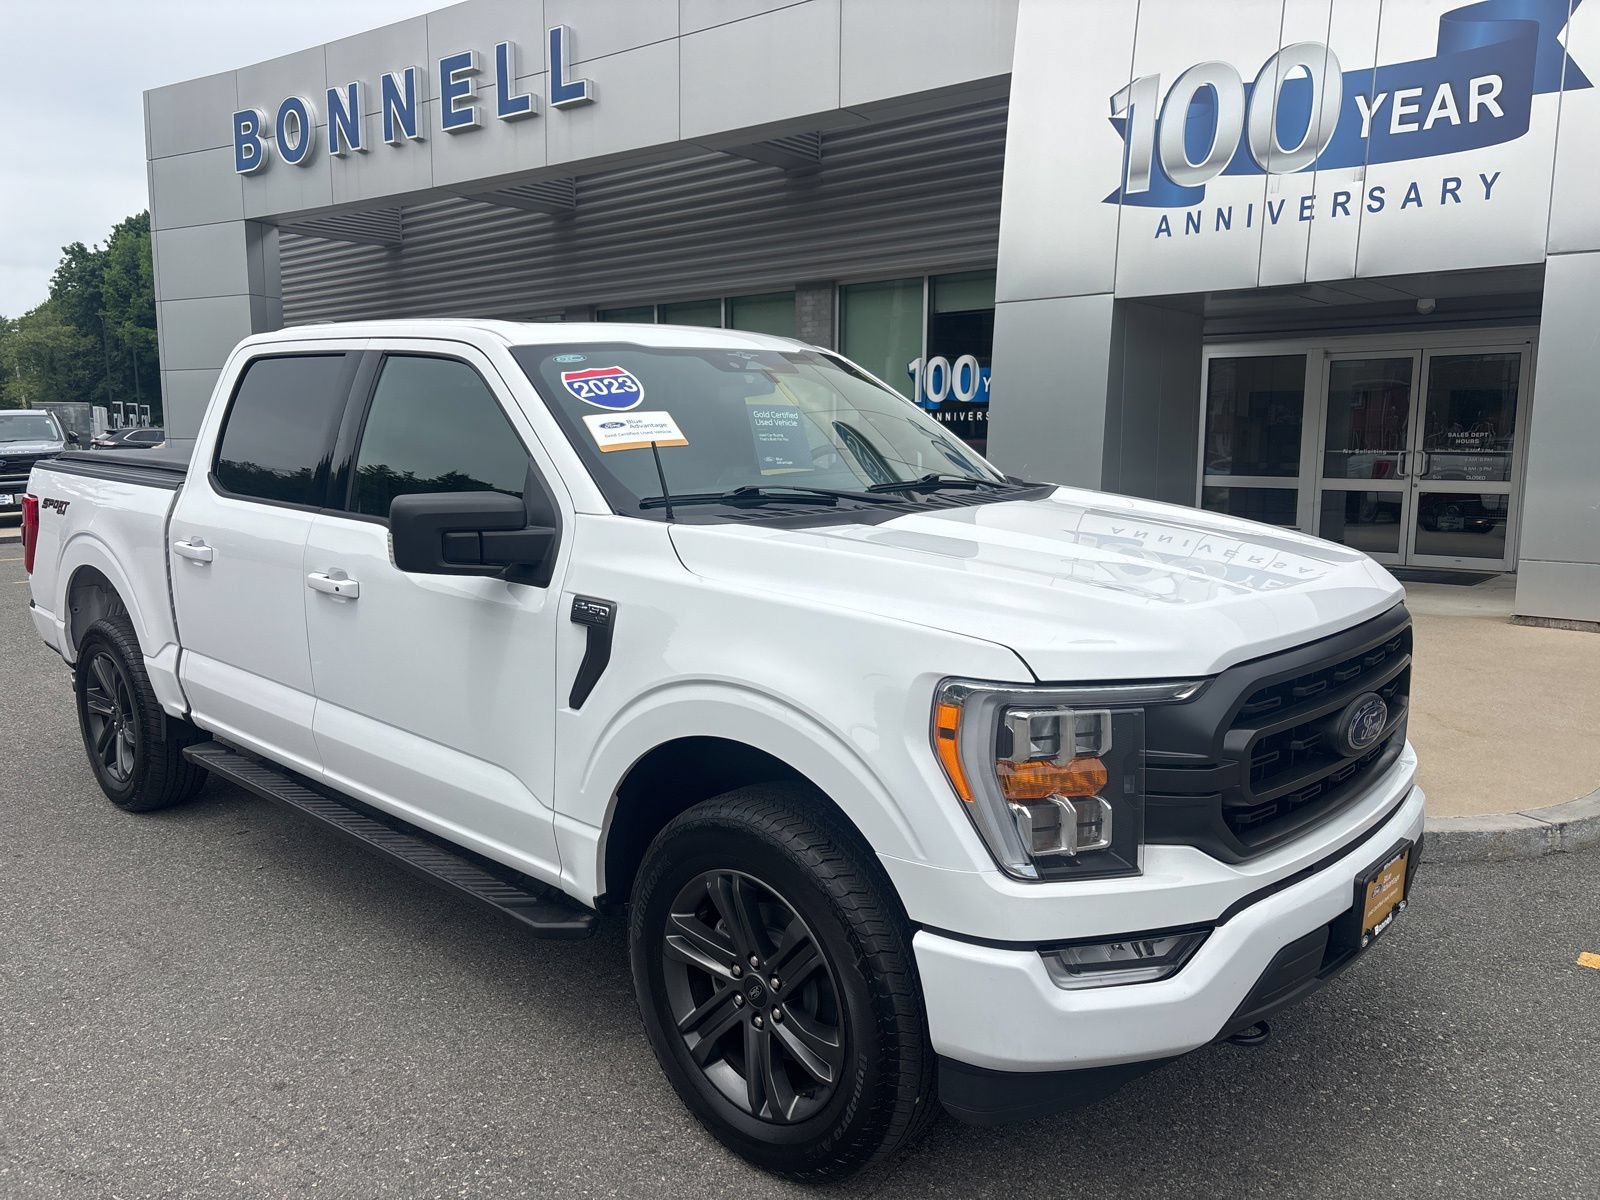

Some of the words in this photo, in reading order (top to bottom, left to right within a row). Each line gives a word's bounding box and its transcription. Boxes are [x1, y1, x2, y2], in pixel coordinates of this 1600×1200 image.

[232, 24, 596, 175] BONNELL
[1109, 41, 1343, 194] 100
[1354, 73, 1505, 139] YEAR
[1154, 171, 1501, 239] ANNIVERSARY
[572, 376, 639, 398] 2023
[908, 354, 980, 403] 100
[753, 410, 770, 418] Gold
[770, 411, 799, 419] Certified
[755, 418, 773, 426] Used
[773, 419, 799, 427] Vehicle
[41, 497, 71, 515] SPORT
